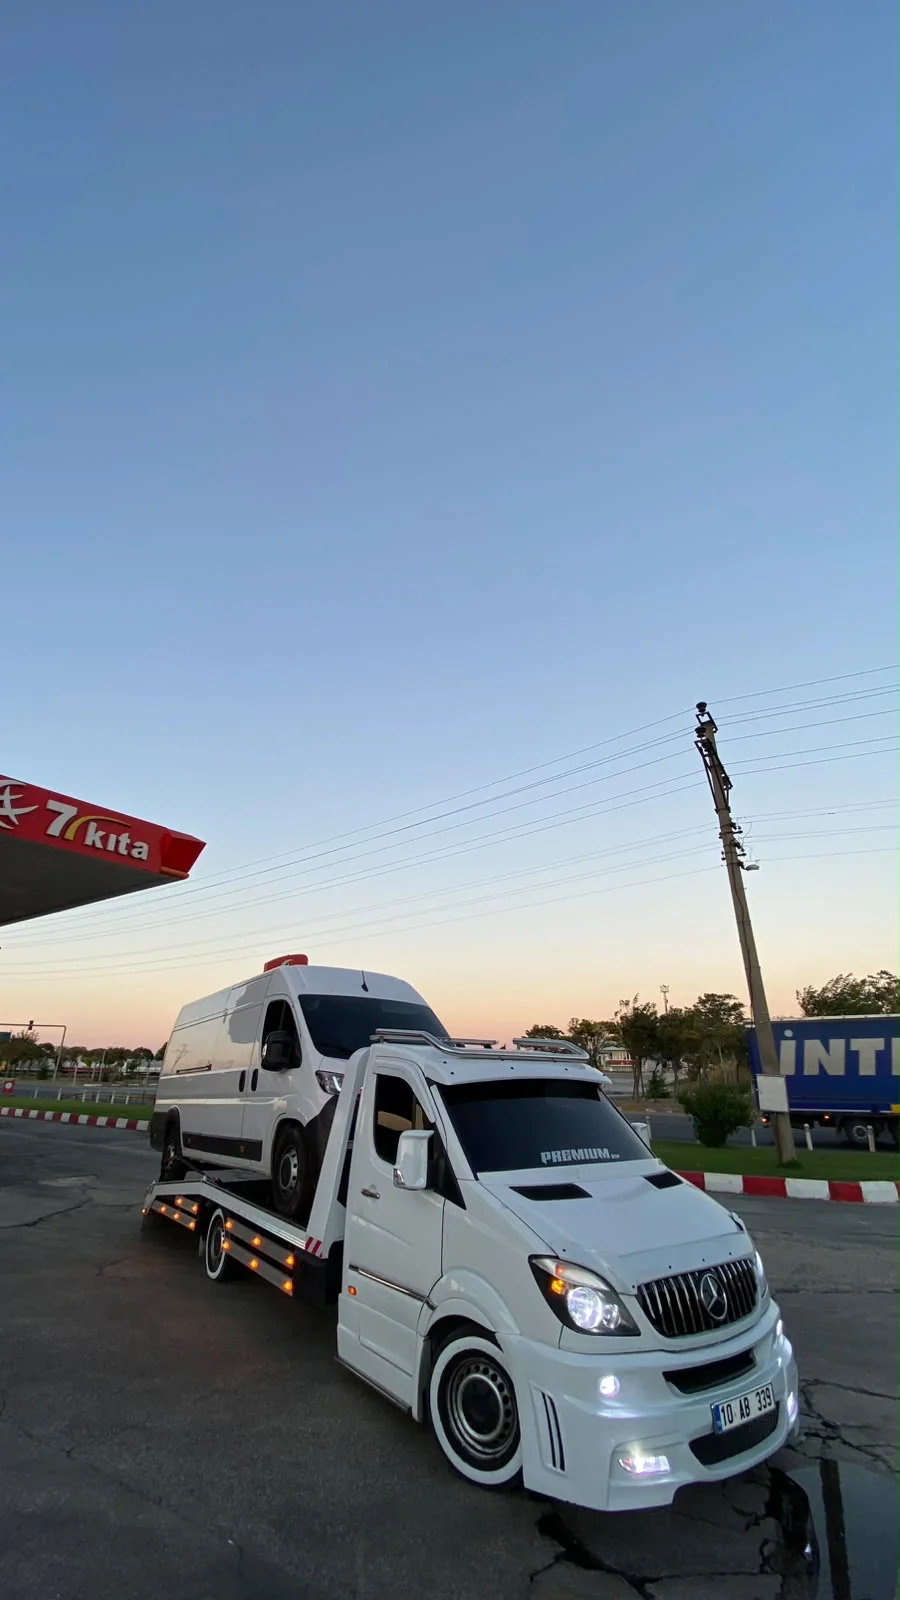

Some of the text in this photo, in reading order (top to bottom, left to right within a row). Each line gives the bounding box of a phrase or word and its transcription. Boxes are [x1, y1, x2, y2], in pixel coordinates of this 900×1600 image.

[540, 1147, 610, 1165] PREMIUM
[721, 1387, 772, 1426] 10 AB 339
